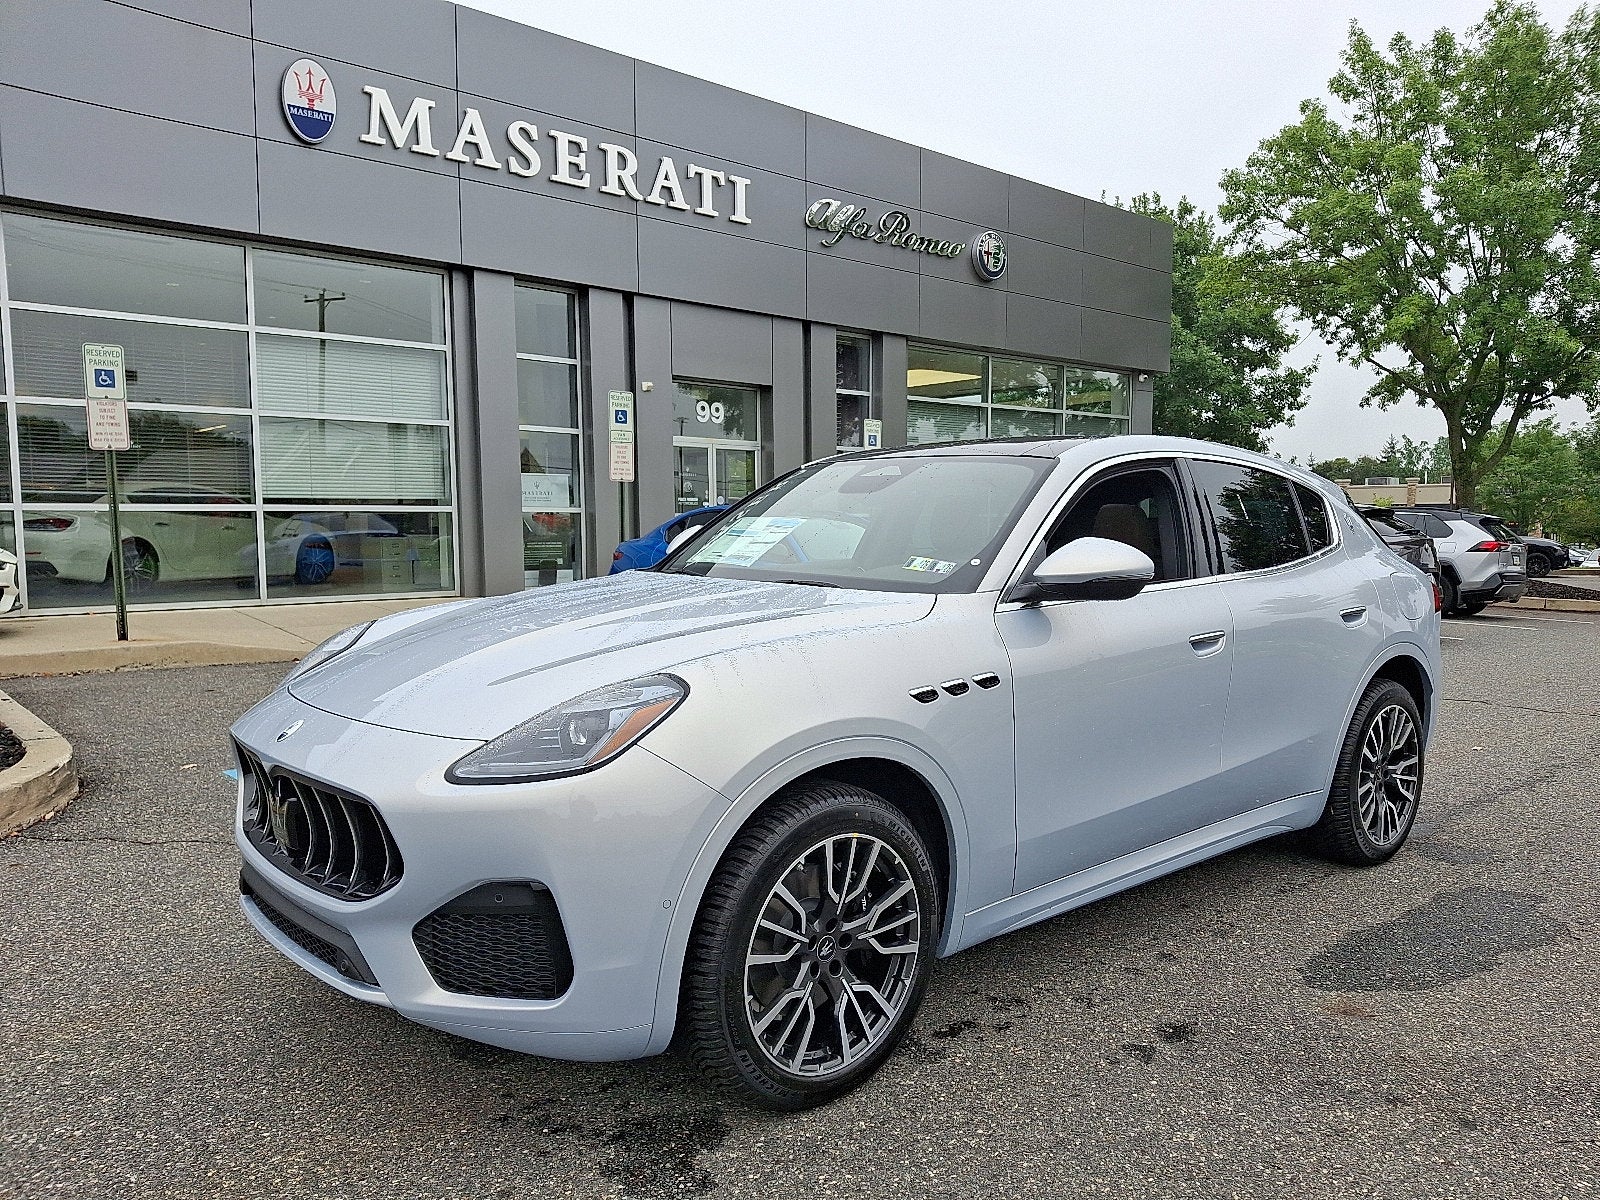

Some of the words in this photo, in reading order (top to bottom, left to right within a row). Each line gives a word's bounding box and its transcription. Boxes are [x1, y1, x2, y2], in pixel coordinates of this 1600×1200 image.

[290, 106, 332, 122] MASERATI
[359, 84, 752, 225] MASERATI
[804, 197, 876, 248] Alfa
[873, 210, 967, 258] Romeo
[86, 349, 121, 358] RESERVED
[88, 358, 119, 367] PARKING
[695, 400, 725, 424] 99
